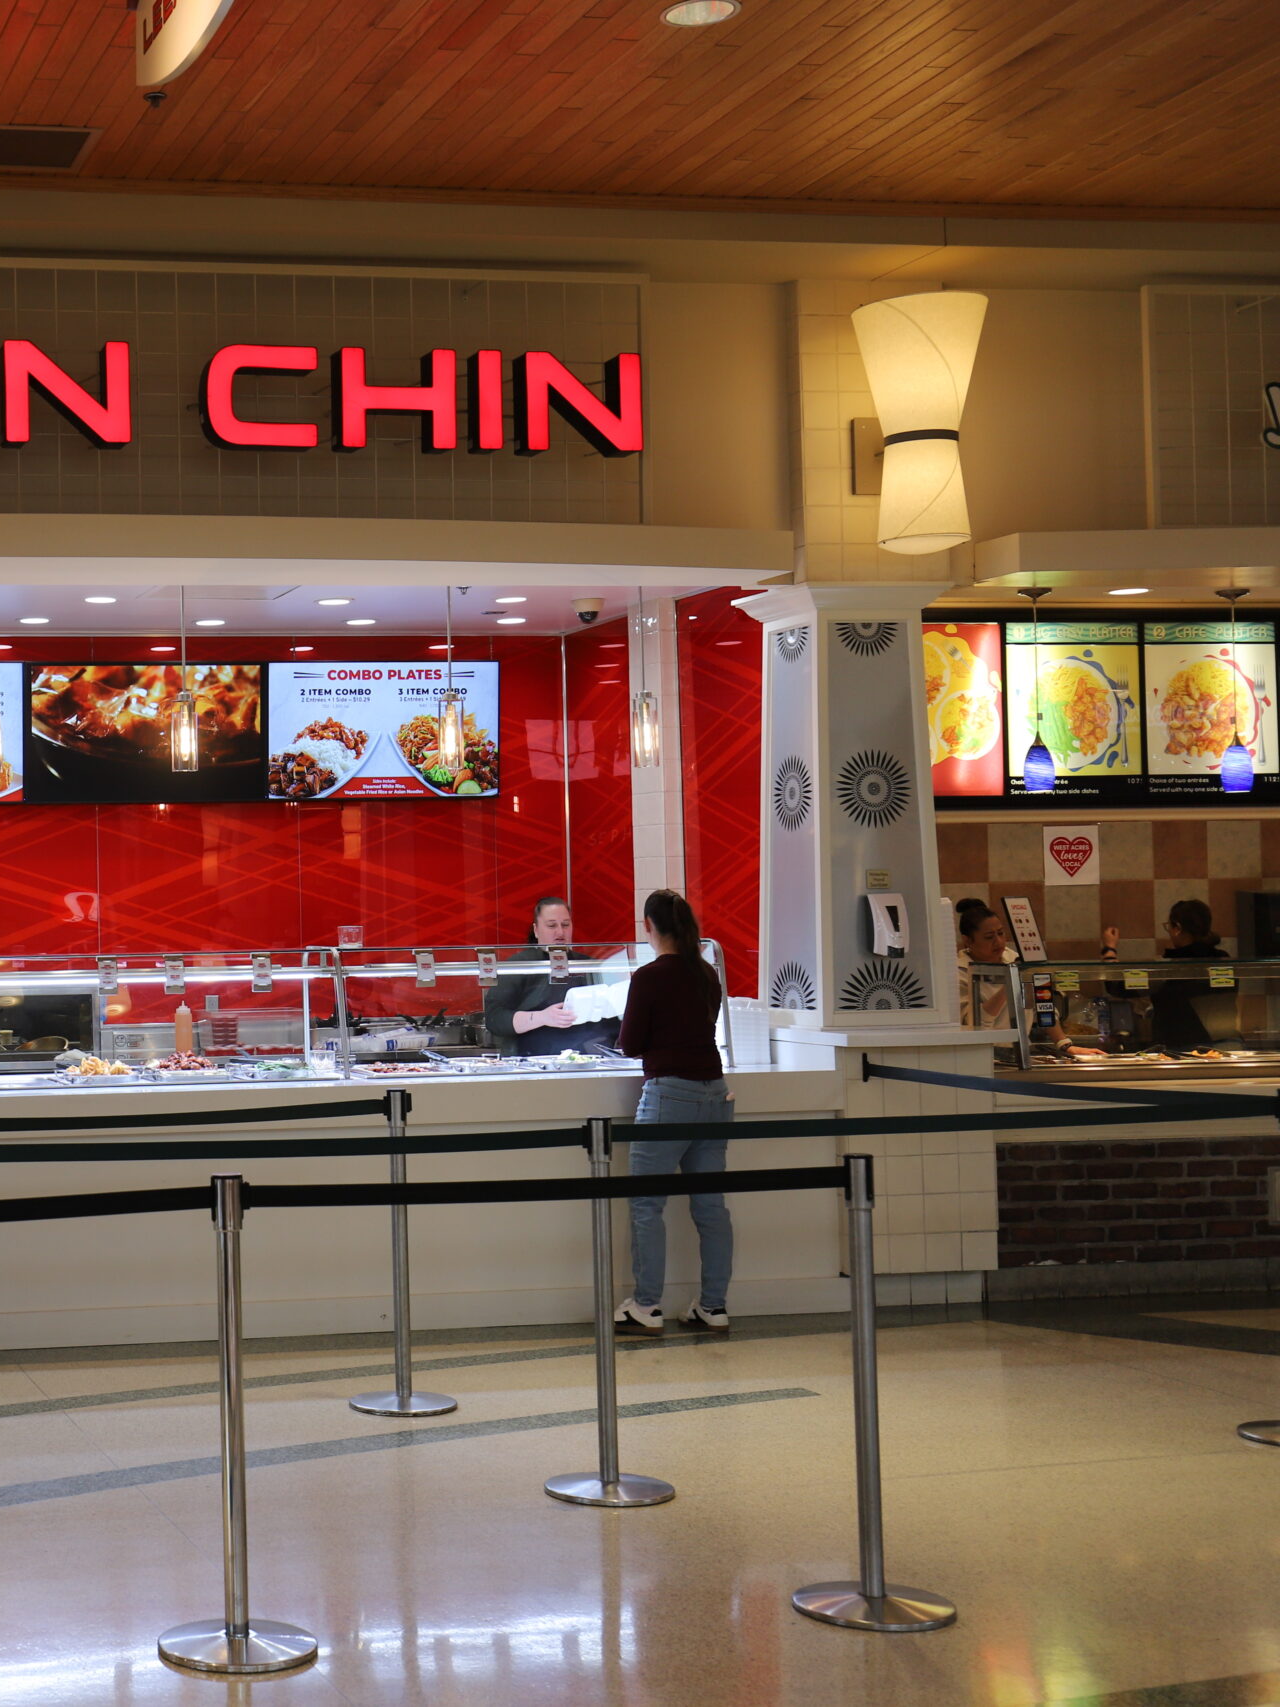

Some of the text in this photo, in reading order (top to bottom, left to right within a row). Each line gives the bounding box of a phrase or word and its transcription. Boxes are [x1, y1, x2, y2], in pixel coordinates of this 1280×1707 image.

[204, 343, 644, 453] CHIN
[1056, 627, 1083, 638] EASY
[1089, 626, 1133, 638] PLATTER
[1175, 626, 1206, 638] CAFE
[1215, 626, 1267, 638] PLATTER
[327, 669, 442, 680] COMBO PLATES
[1060, 850, 1085, 860] loves
